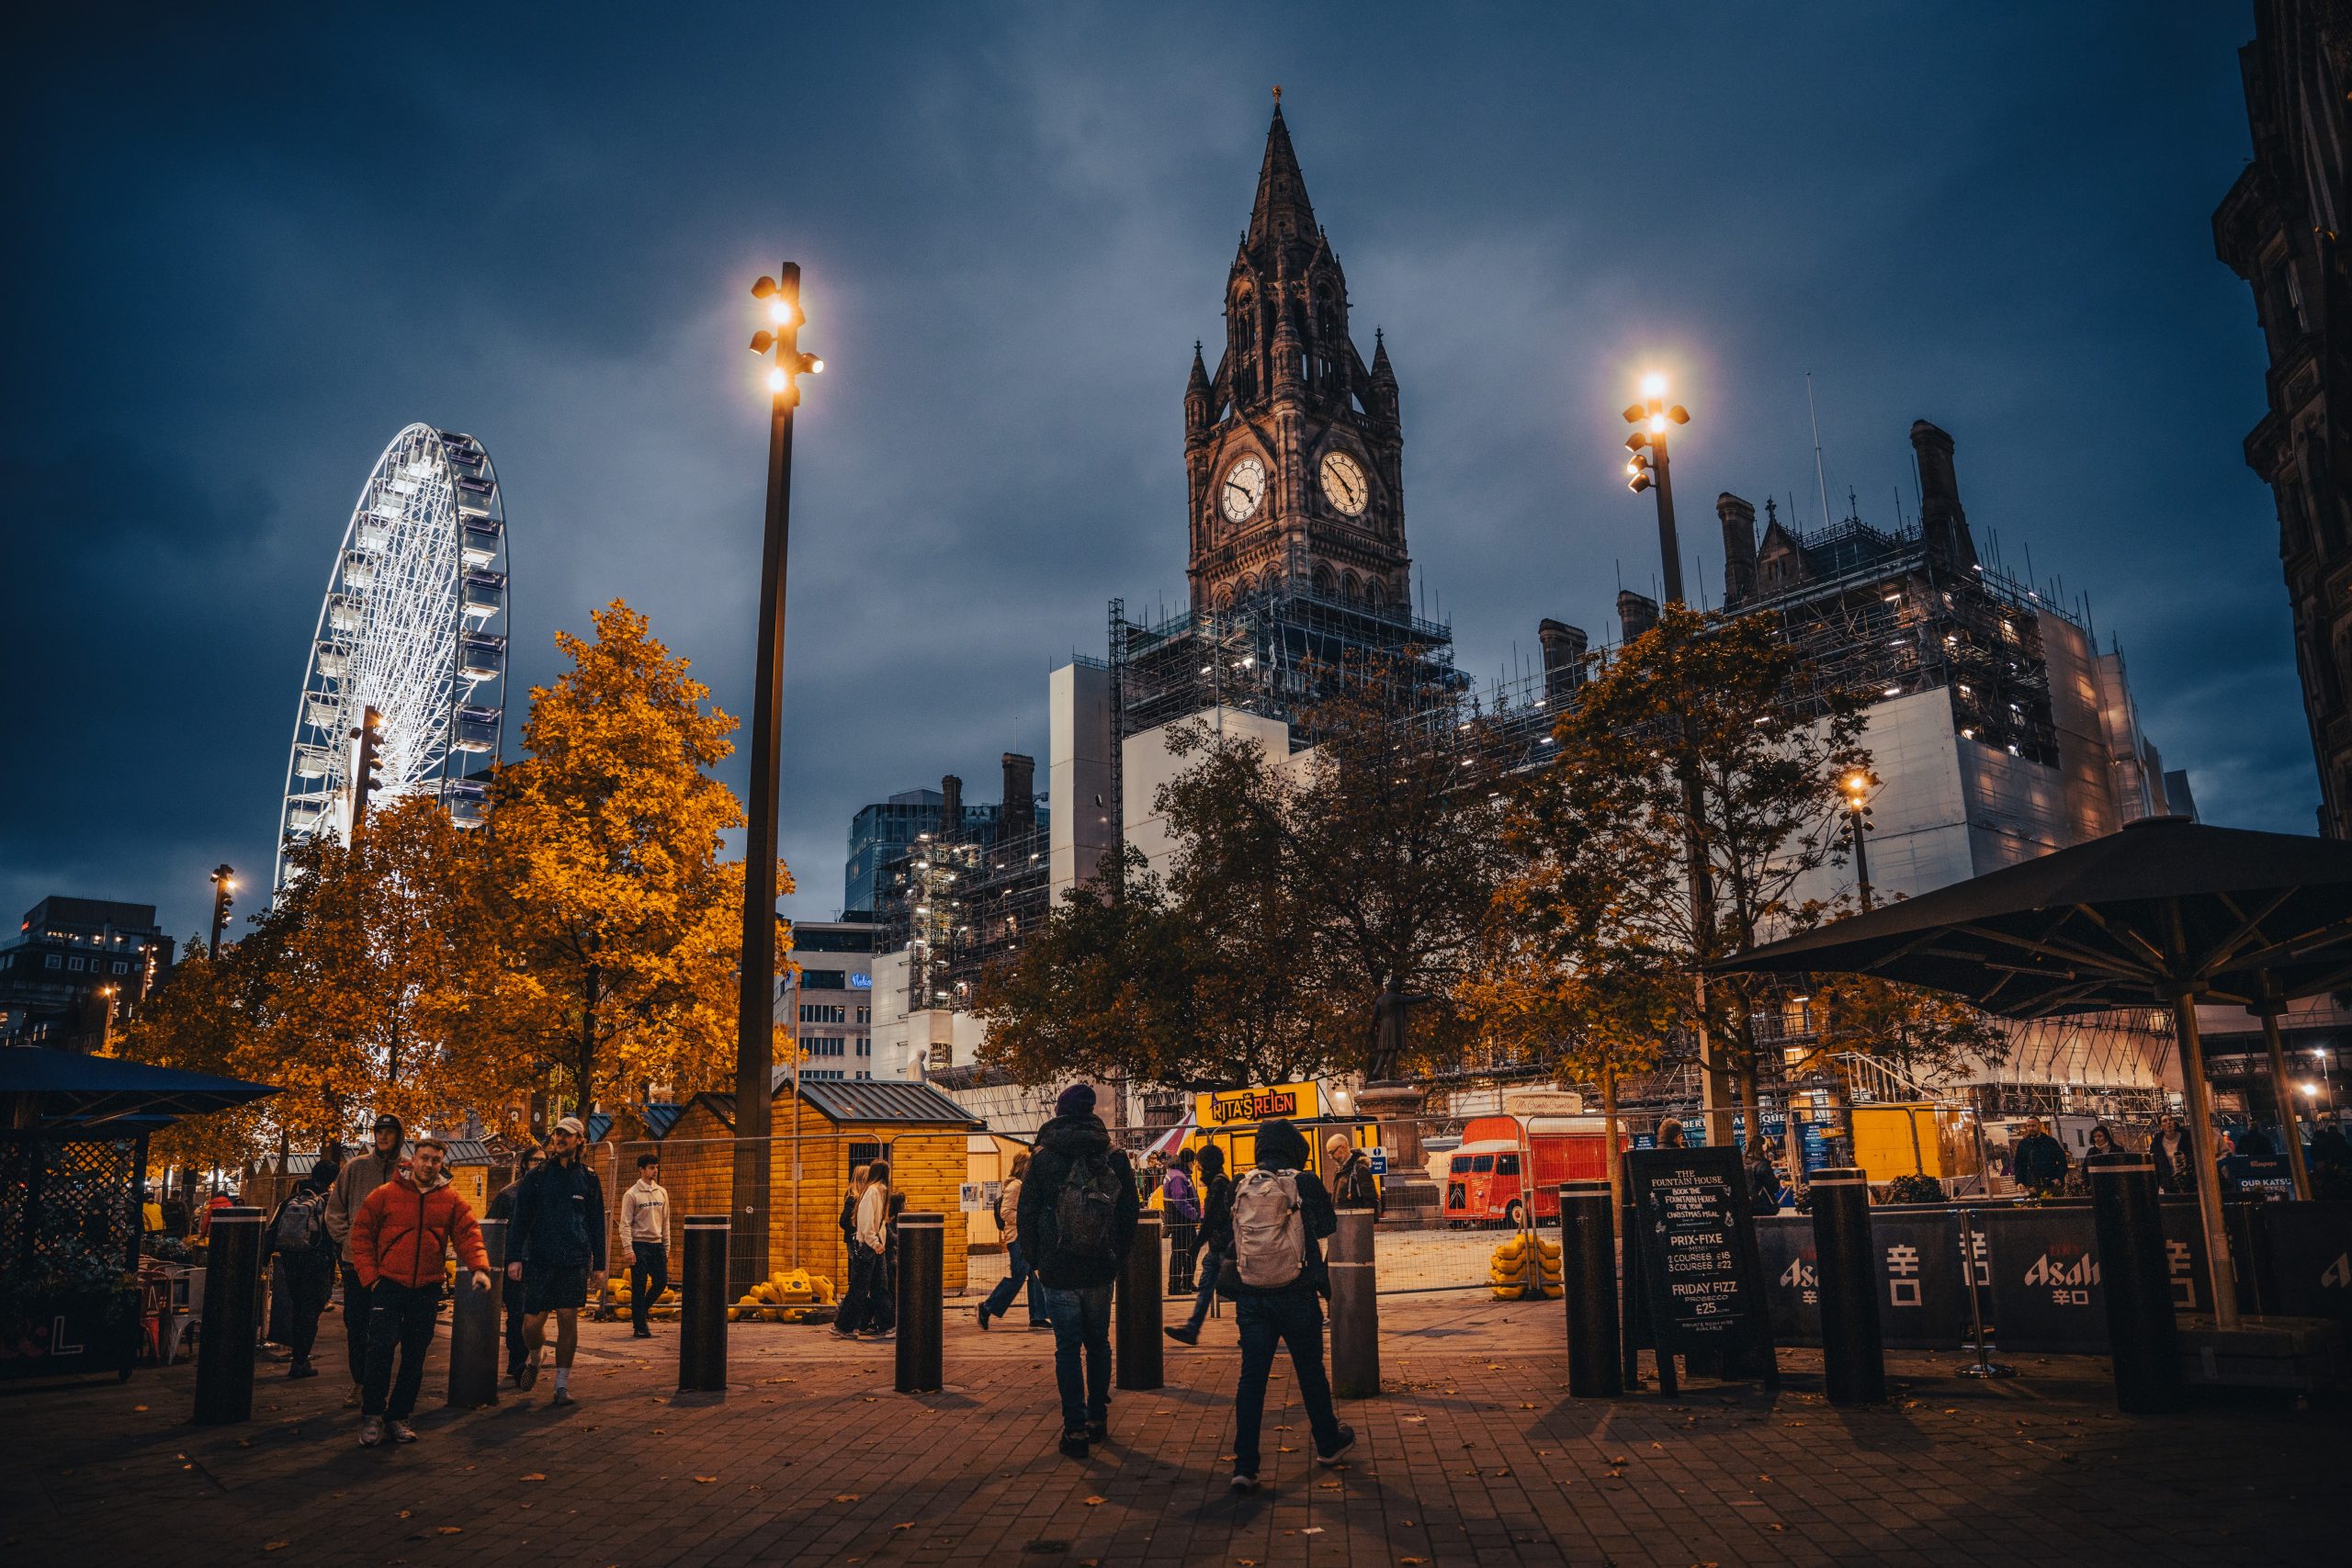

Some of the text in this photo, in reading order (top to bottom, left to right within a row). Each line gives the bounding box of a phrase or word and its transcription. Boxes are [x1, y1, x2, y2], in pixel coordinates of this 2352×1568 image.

[1213, 1090, 1294, 1122] RITA'S REIGN
[1651, 1176, 1724, 1187] FOUNTAIN HOUSE
[1664, 1195, 1697, 1203] FOUNTAIN
[1667, 1211, 1701, 1219] CHRISTMAS
[1670, 1234, 1724, 1247] PRIX-FIXE
[1668, 1251, 1731, 1263] 2 COURSES £18
[1668, 1260, 1733, 1272] 3 COURSES £22
[2024, 1253, 2101, 1286] Asah
[1886, 1244, 1923, 1307] 辛口
[1672, 1280, 1738, 1296] FRIDAY FIZZ
[1684, 1294, 1729, 1303] PROSECCO
[1802, 1290, 1818, 1305] 辛
[2052, 1289, 2089, 1305] 辛口
[1695, 1303, 1717, 1314] £25
